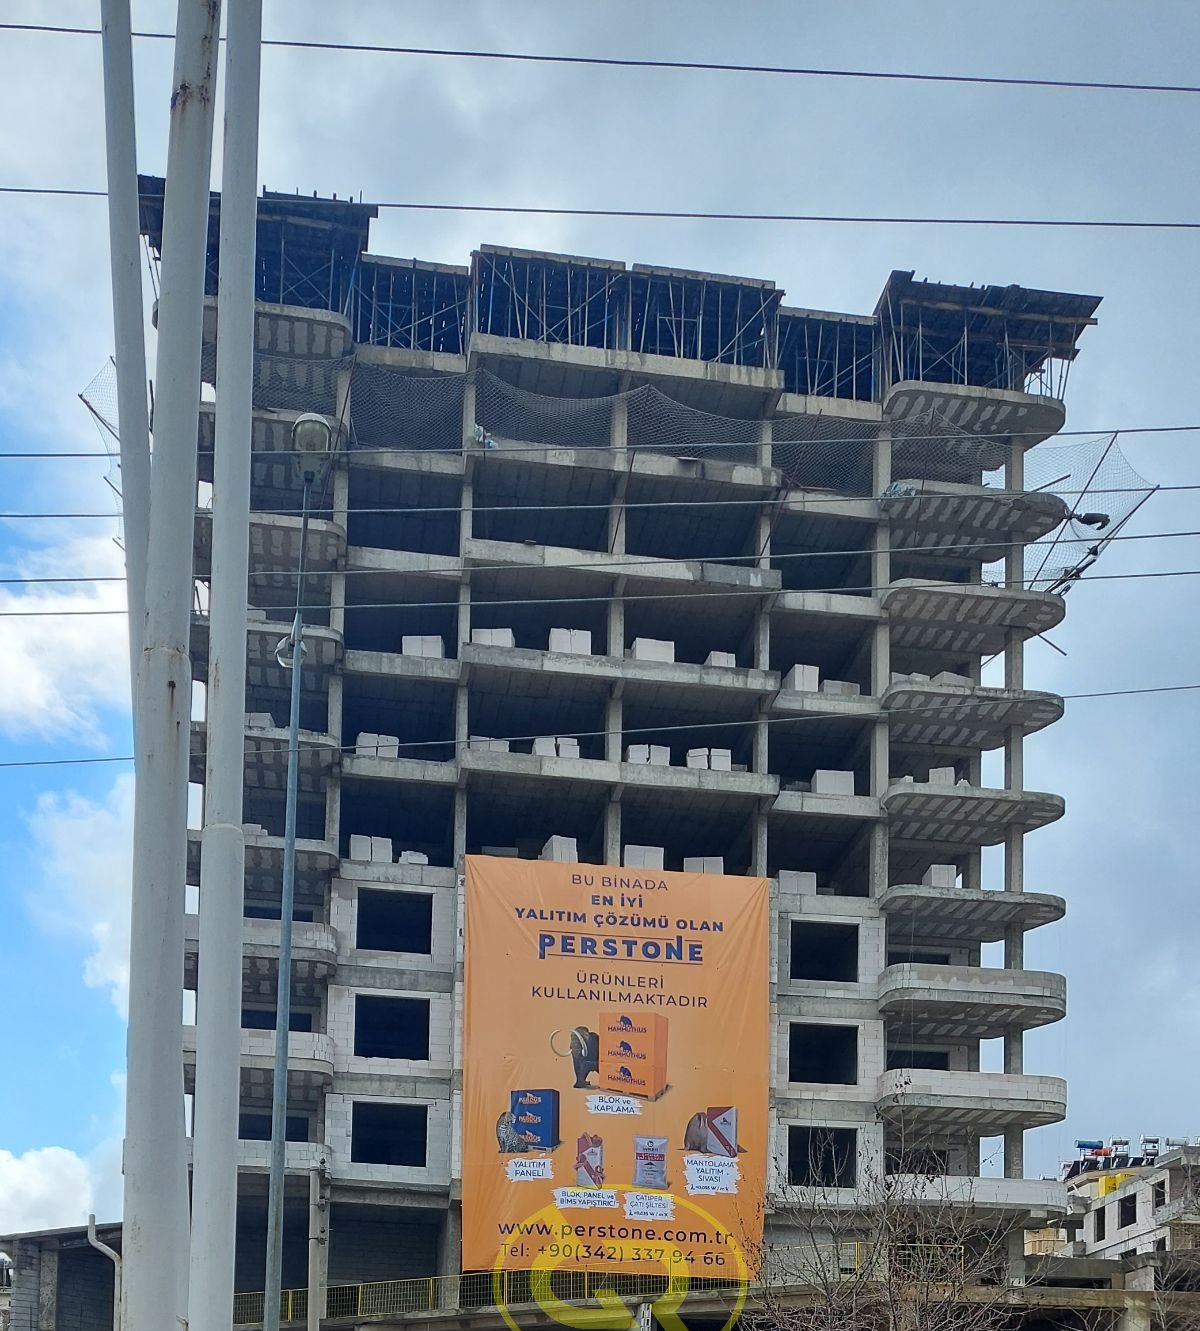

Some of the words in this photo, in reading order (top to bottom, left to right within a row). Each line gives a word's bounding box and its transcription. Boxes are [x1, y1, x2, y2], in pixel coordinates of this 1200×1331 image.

[571, 873, 594, 887] BU
[601, 873, 668, 892] BİNADA
[591, 893, 614, 907] EN
[620, 892, 643, 909] İYİ
[515, 907, 587, 924] YALITIM
[595, 911, 669, 929] ÇÖZÜMÜ
[676, 918, 724, 933] OLAN
[538, 933, 704, 962] PERSTONE
[576, 970, 664, 989] ÜRÜNLERİ
[532, 985, 708, 1009] KULLANILMAKTADIR
[598, 1096, 621, 1104] BLOK
[594, 1104, 635, 1114] KAPLAMA
[513, 1161, 546, 1169] YALITIM
[686, 1159, 735, 1169] MANTOLAMA
[695, 1167, 724, 1175] YALITIM
[514, 1169, 544, 1178] PANELİ
[583, 1192, 606, 1200] PANEL
[498, 1222, 734, 1245] www.perstone.com.tr
[501, 1243, 530, 1258] Tel:
[537, 1243, 624, 1263] +90(342)
[631, 1247, 665, 1263] 337
[671, 1249, 697, 1264] 94
[702, 1251, 726, 1266] 66
